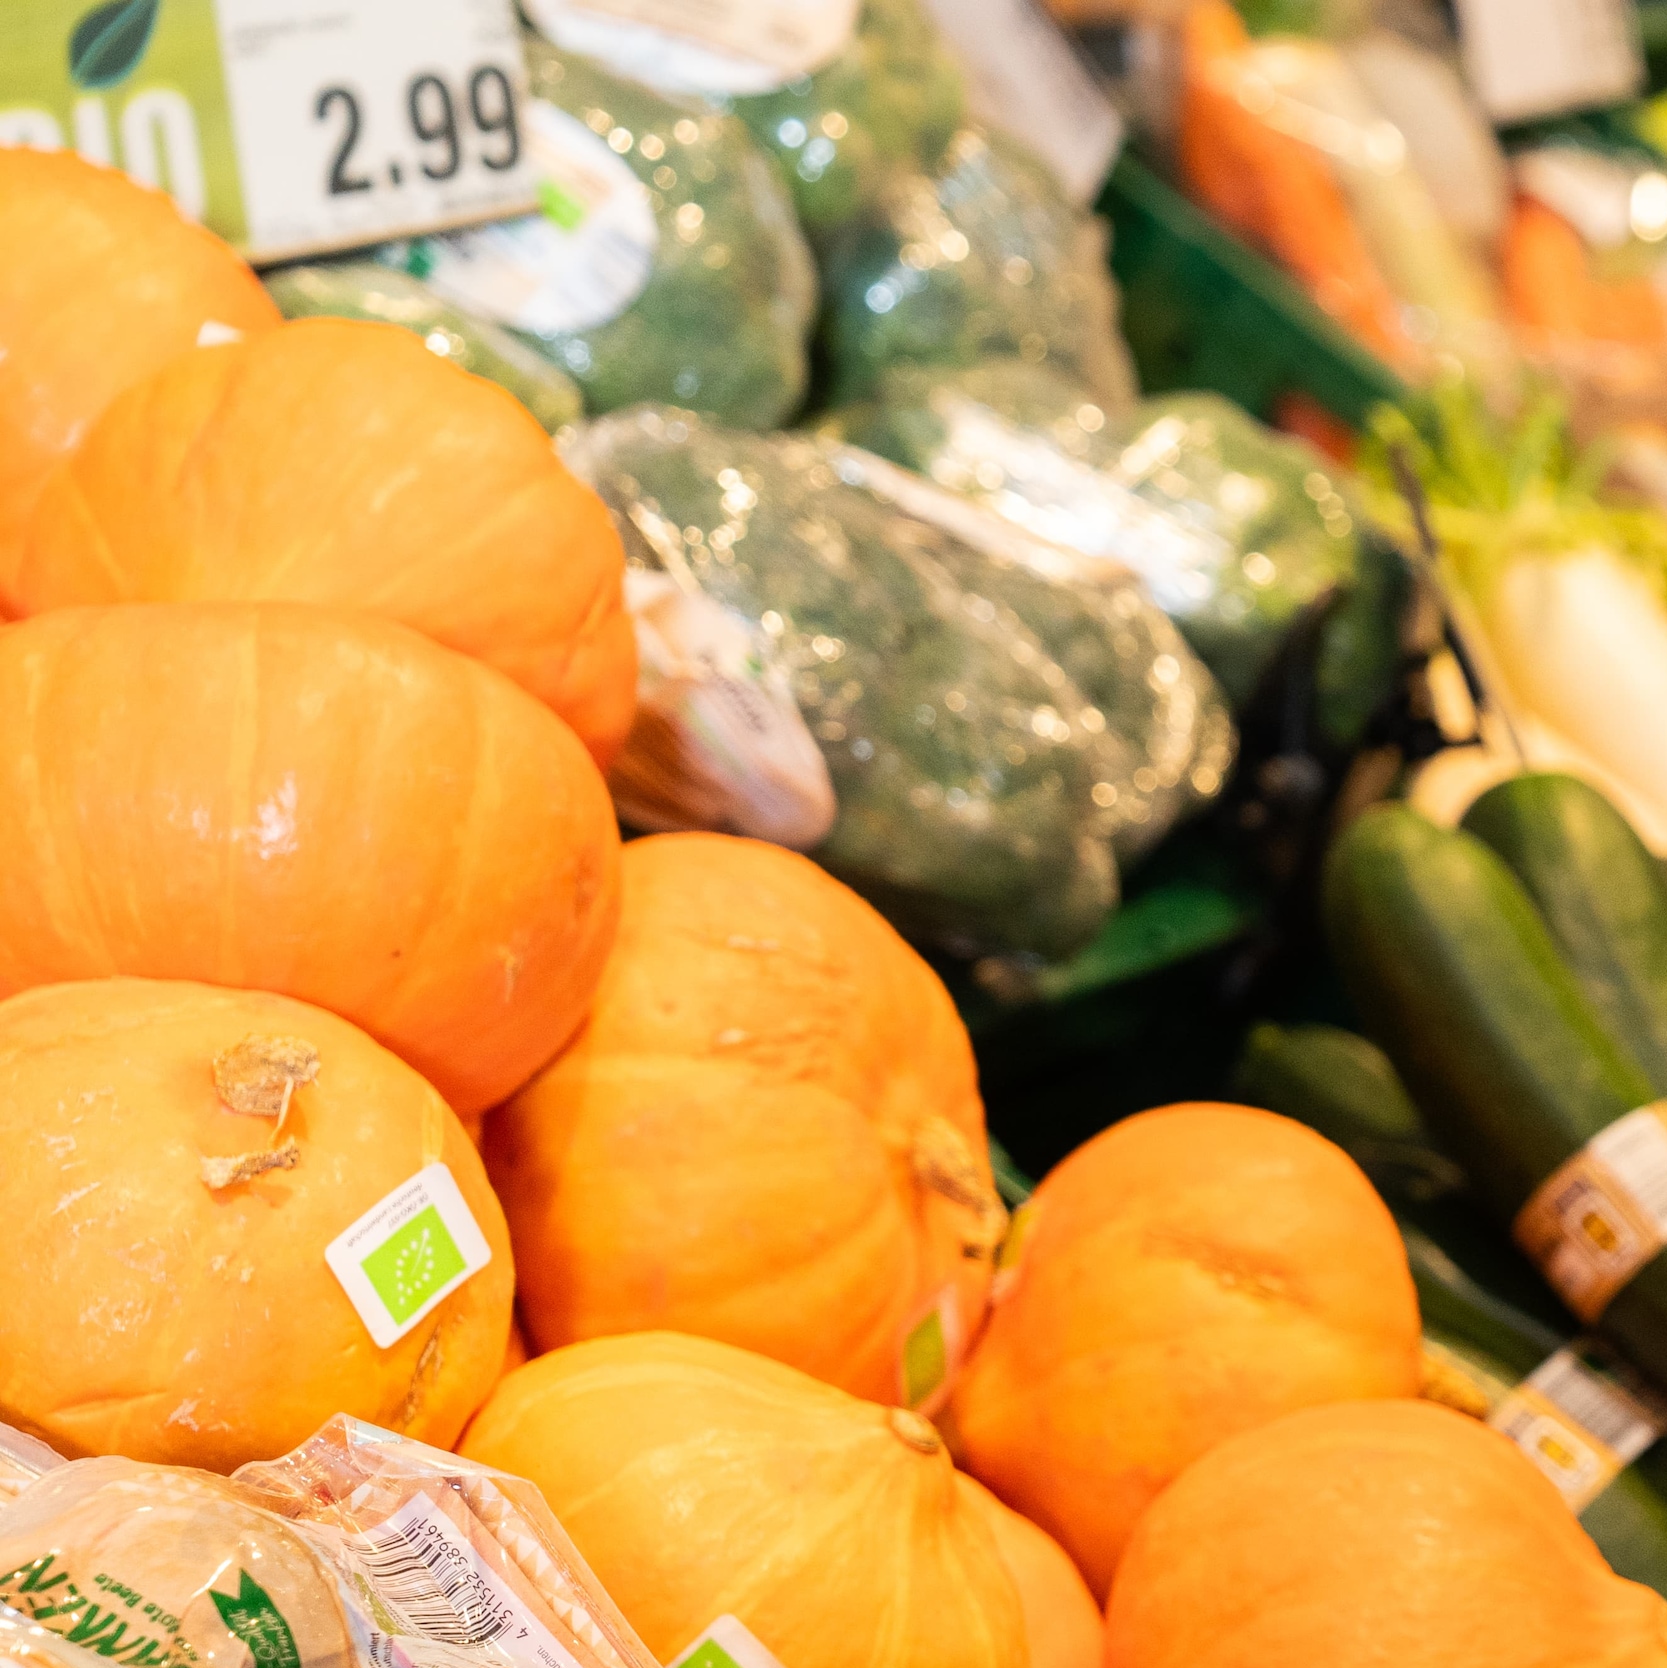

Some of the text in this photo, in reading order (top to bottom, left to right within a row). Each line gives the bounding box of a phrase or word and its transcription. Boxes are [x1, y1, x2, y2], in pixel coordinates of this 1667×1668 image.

[313, 64, 522, 197] 2.99
[416, 1517, 530, 1640] 4 311532 389461
